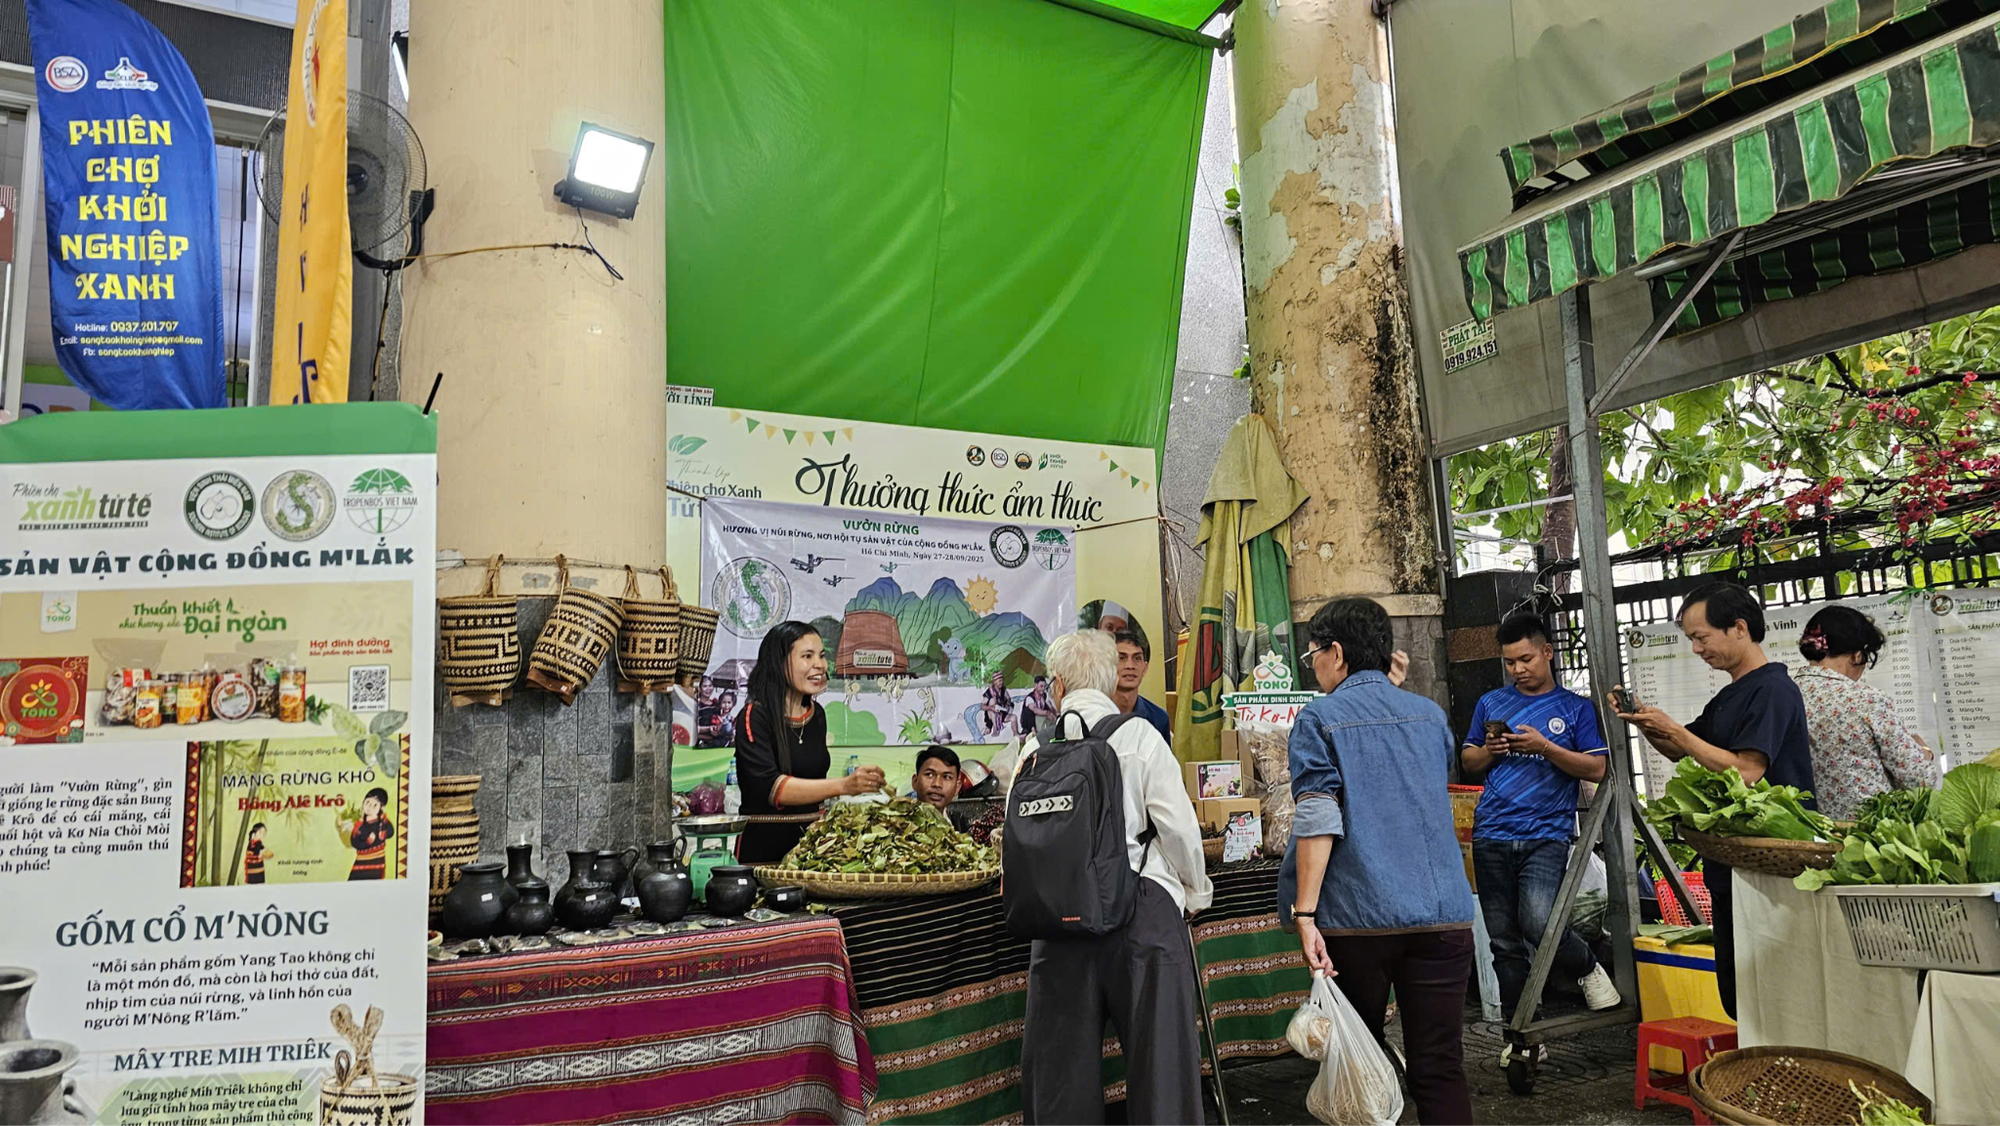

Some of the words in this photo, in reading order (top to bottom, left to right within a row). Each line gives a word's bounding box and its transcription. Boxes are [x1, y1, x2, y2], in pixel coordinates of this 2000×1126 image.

[54, 66, 80, 78] BSA
[69, 114, 172, 145] PHIÊN
[86, 154, 160, 189] CHỢ
[78, 189, 167, 222] KHỞI
[60, 229, 189, 266] NGHIỆP
[75, 273, 175, 300] XANH
[75, 324, 108, 332] Hotline:
[110, 321, 179, 333] 0937.201.797
[1448, 329, 1470, 347] PHÁT
[1444, 340, 1498, 370] 0919.924.151
[343, 496, 383, 507] TROPENBOS
[401, 496, 418, 507] NAM
[728, 484, 762, 498] Xanh
[795, 453, 930, 516] Thưởng
[938, 471, 996, 516] thức
[1003, 480, 1045, 519] ẩm
[1051, 480, 1104, 529] thực
[20, 486, 97, 521] xanh
[723, 525, 758, 535] HƯƠNG
[760, 527, 769, 537] VỊ
[771, 527, 786, 536] NÚI
[788, 529, 815, 540] RỪNG,
[817, 531, 832, 540] NƠI
[834, 533, 849, 543] HỘI
[851, 535, 861, 544] TỤ
[881, 536, 895, 547] VẬT
[914, 538, 936, 549] CỘNG
[843, 518, 881, 532] VƯỜN
[884, 521, 919, 535] RỪNG
[0, 550, 60, 576] SẢN
[69, 550, 131, 580] VẬT
[138, 548, 217, 578] CỘNG
[226, 541, 311, 569] ĐỒNG
[320, 536, 414, 566] M'LẮK
[46, 615, 71, 623] TONO
[185, 615, 220, 639] Đại
[227, 610, 287, 643] ngàn
[310, 639, 328, 650] Hạt
[331, 639, 354, 649] dinh
[357, 637, 391, 650] dưỡng
[1256, 680, 1289, 690] TONO
[1233, 695, 1246, 704] SẢN
[1271, 695, 1288, 703] DINH
[20, 707, 58, 719] TONO
[30, 782, 54, 794] làm
[153, 778, 172, 792] gìn
[280, 769, 332, 787] RỪNG
[338, 766, 376, 784] KHÔ
[7, 796, 43, 812] giống
[45, 798, 57, 809] le
[60, 796, 90, 810] rừng
[92, 793, 113, 810] đặc
[116, 793, 138, 806] sản
[140, 795, 172, 807] Bung
[284, 795, 311, 809] Alê
[314, 793, 346, 808] Krô
[56, 909, 136, 947] GỐM
[143, 904, 186, 942] CỔ
[194, 903, 329, 941] M'NÔNG
[131, 958, 156, 972] sản
[160, 956, 201, 973] phẩm
[204, 953, 236, 970] gốm
[240, 953, 276, 968] Yang
[280, 952, 305, 964] Tao
[309, 950, 351, 964] không
[87, 980, 101, 992] là
[105, 978, 134, 993] một
[138, 977, 169, 990] món
[199, 974, 221, 986] mà
[225, 972, 250, 985] còn
[254, 970, 267, 983] là
[271, 969, 293, 982] hơi
[297, 968, 321, 981] thở
[323, 967, 348, 979] của
[352, 965, 379, 980] đất,
[113, 1047, 166, 1072] MÂY
[169, 1048, 213, 1068] TRE
[217, 1046, 262, 1065] MIH
[267, 1037, 331, 1062] TRIÊK
[191, 1086, 212, 1097] Mih
[215, 1083, 245, 1096] Triêk
[248, 1081, 283, 1095] không
